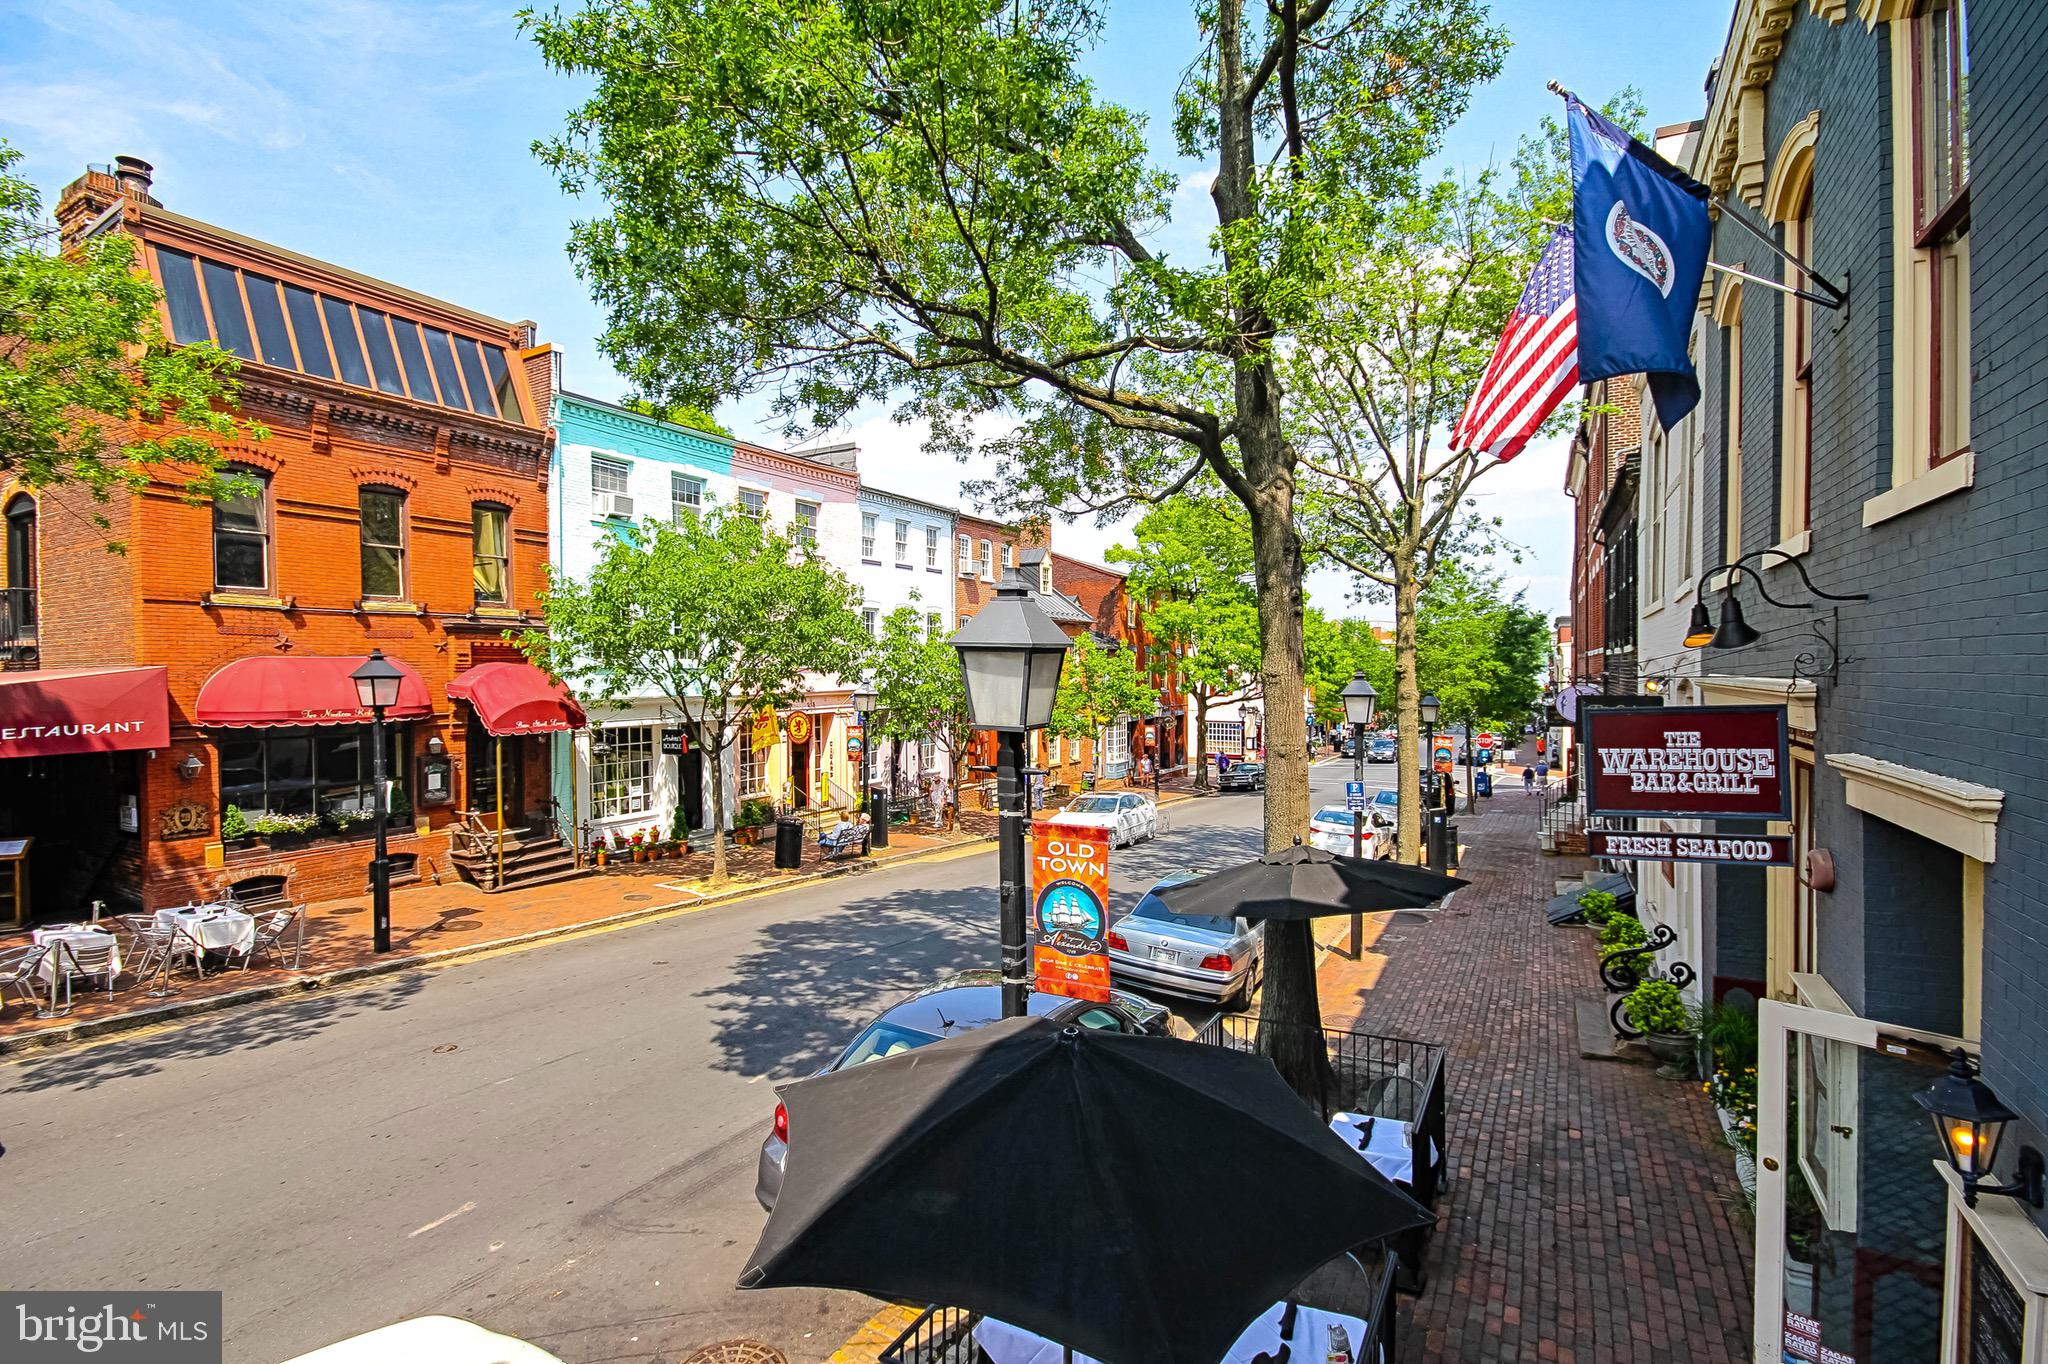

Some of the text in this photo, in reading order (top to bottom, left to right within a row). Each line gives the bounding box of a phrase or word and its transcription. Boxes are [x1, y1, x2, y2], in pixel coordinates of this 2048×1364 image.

[0, 721, 145, 741] ESTAURANT
[1663, 731, 1701, 748] THE
[1598, 748, 1776, 778] WAREHOUSE
[1352, 783, 1359, 793] P
[1047, 841, 1095, 859] OLD
[1605, 835, 1773, 861] FRESH SEAFOOD
[1036, 856, 1105, 878] TOWN
[1055, 880, 1084, 890] WELCOME
[1074, 963, 1105, 971] CELEBRATE
[1787, 1312, 1820, 1328] ZAGAT
[1787, 1318, 1820, 1335] RATED
[1785, 1332, 1818, 1348] ZAGAT
[1785, 1338, 1818, 1355] RATED
[1821, 1347, 1855, 1364] ZAGAT
